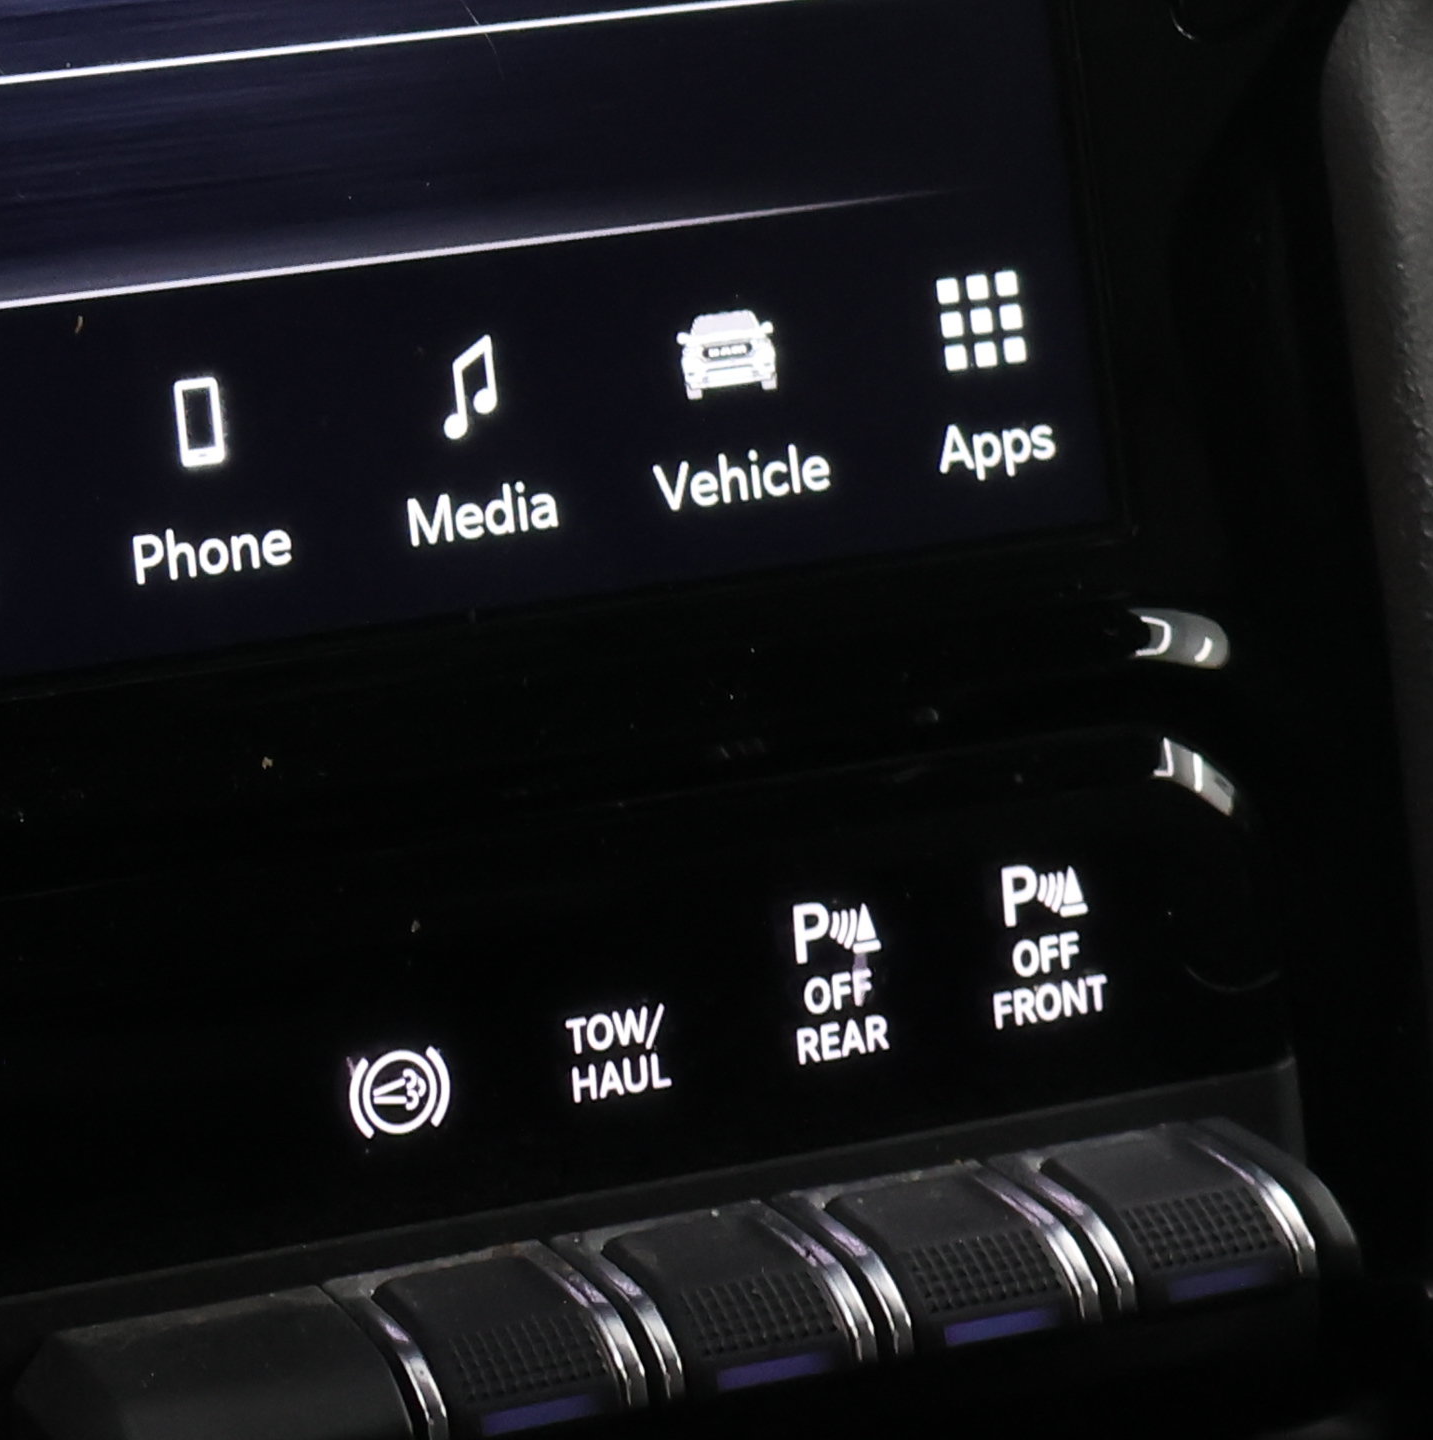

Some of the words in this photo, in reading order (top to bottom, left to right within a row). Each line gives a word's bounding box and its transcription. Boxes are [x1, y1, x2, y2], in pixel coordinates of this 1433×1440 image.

[653, 445, 830, 510] Vehicle
[940, 425, 1055, 480] Apps
[407, 482, 558, 546] Media
[133, 529, 291, 584] Phone
[1013, 932, 1078, 977] OFF
[804, 968, 871, 1014] OFF
[994, 975, 1106, 1028] FRONT
[566, 1005, 664, 1053] TOW/
[797, 1016, 889, 1064] REAR
[572, 1054, 671, 1102] HAUL
